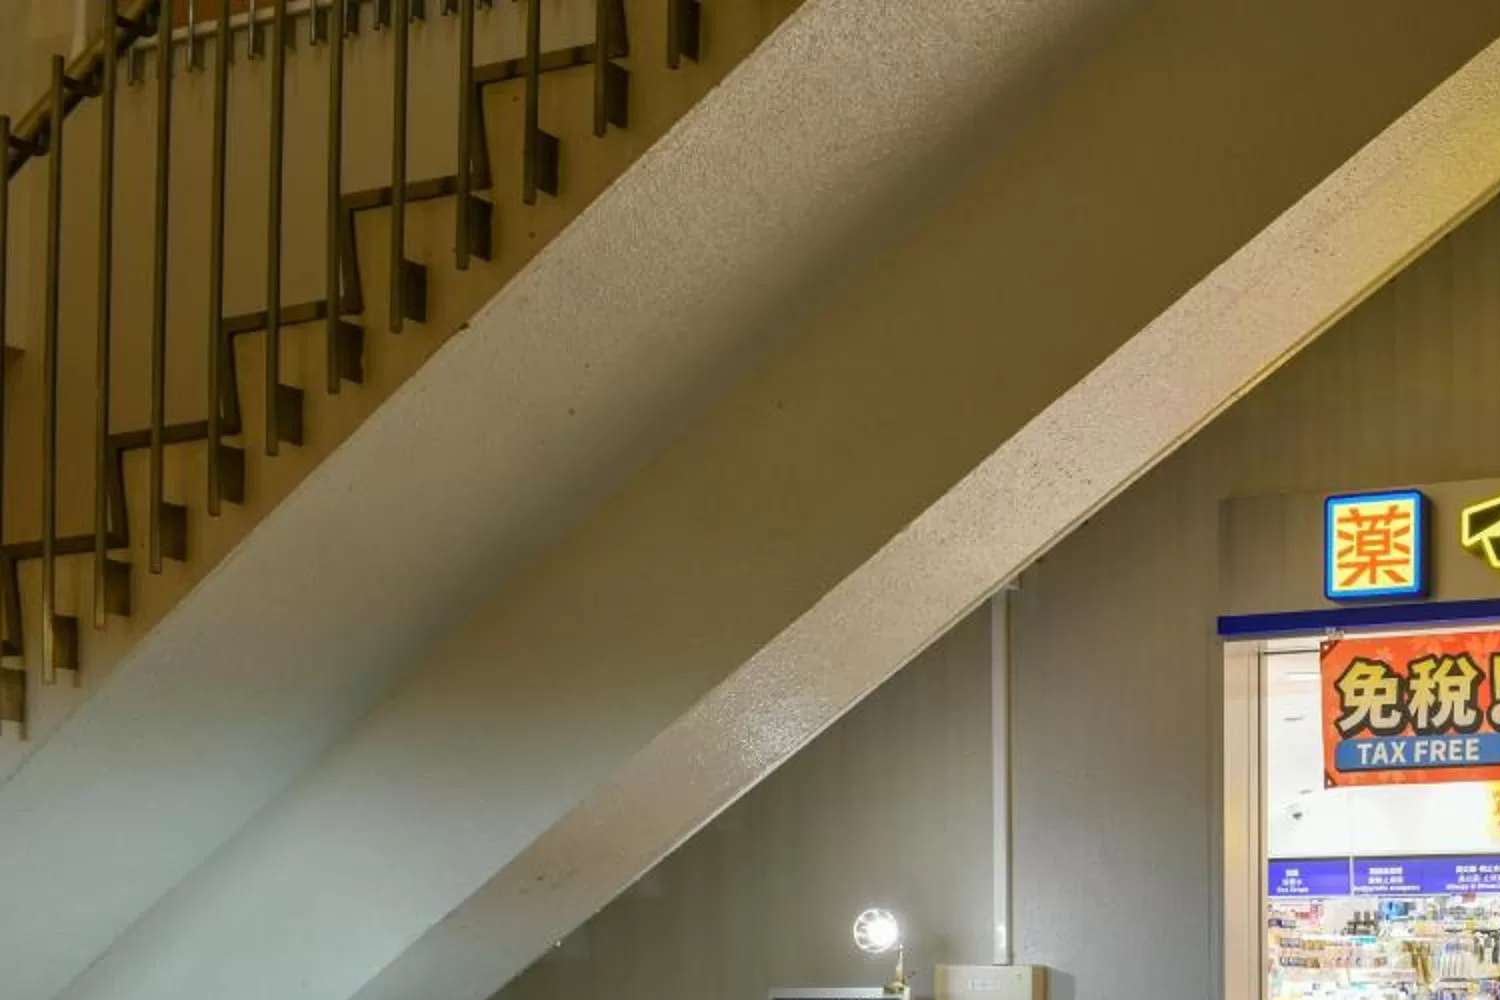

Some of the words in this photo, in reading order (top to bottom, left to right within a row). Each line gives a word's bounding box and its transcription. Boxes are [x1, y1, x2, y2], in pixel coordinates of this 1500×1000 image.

[1338, 507, 1410, 587] 薬
[1356, 742, 1412, 765] TAX
[1414, 738, 1480, 761] FREE
